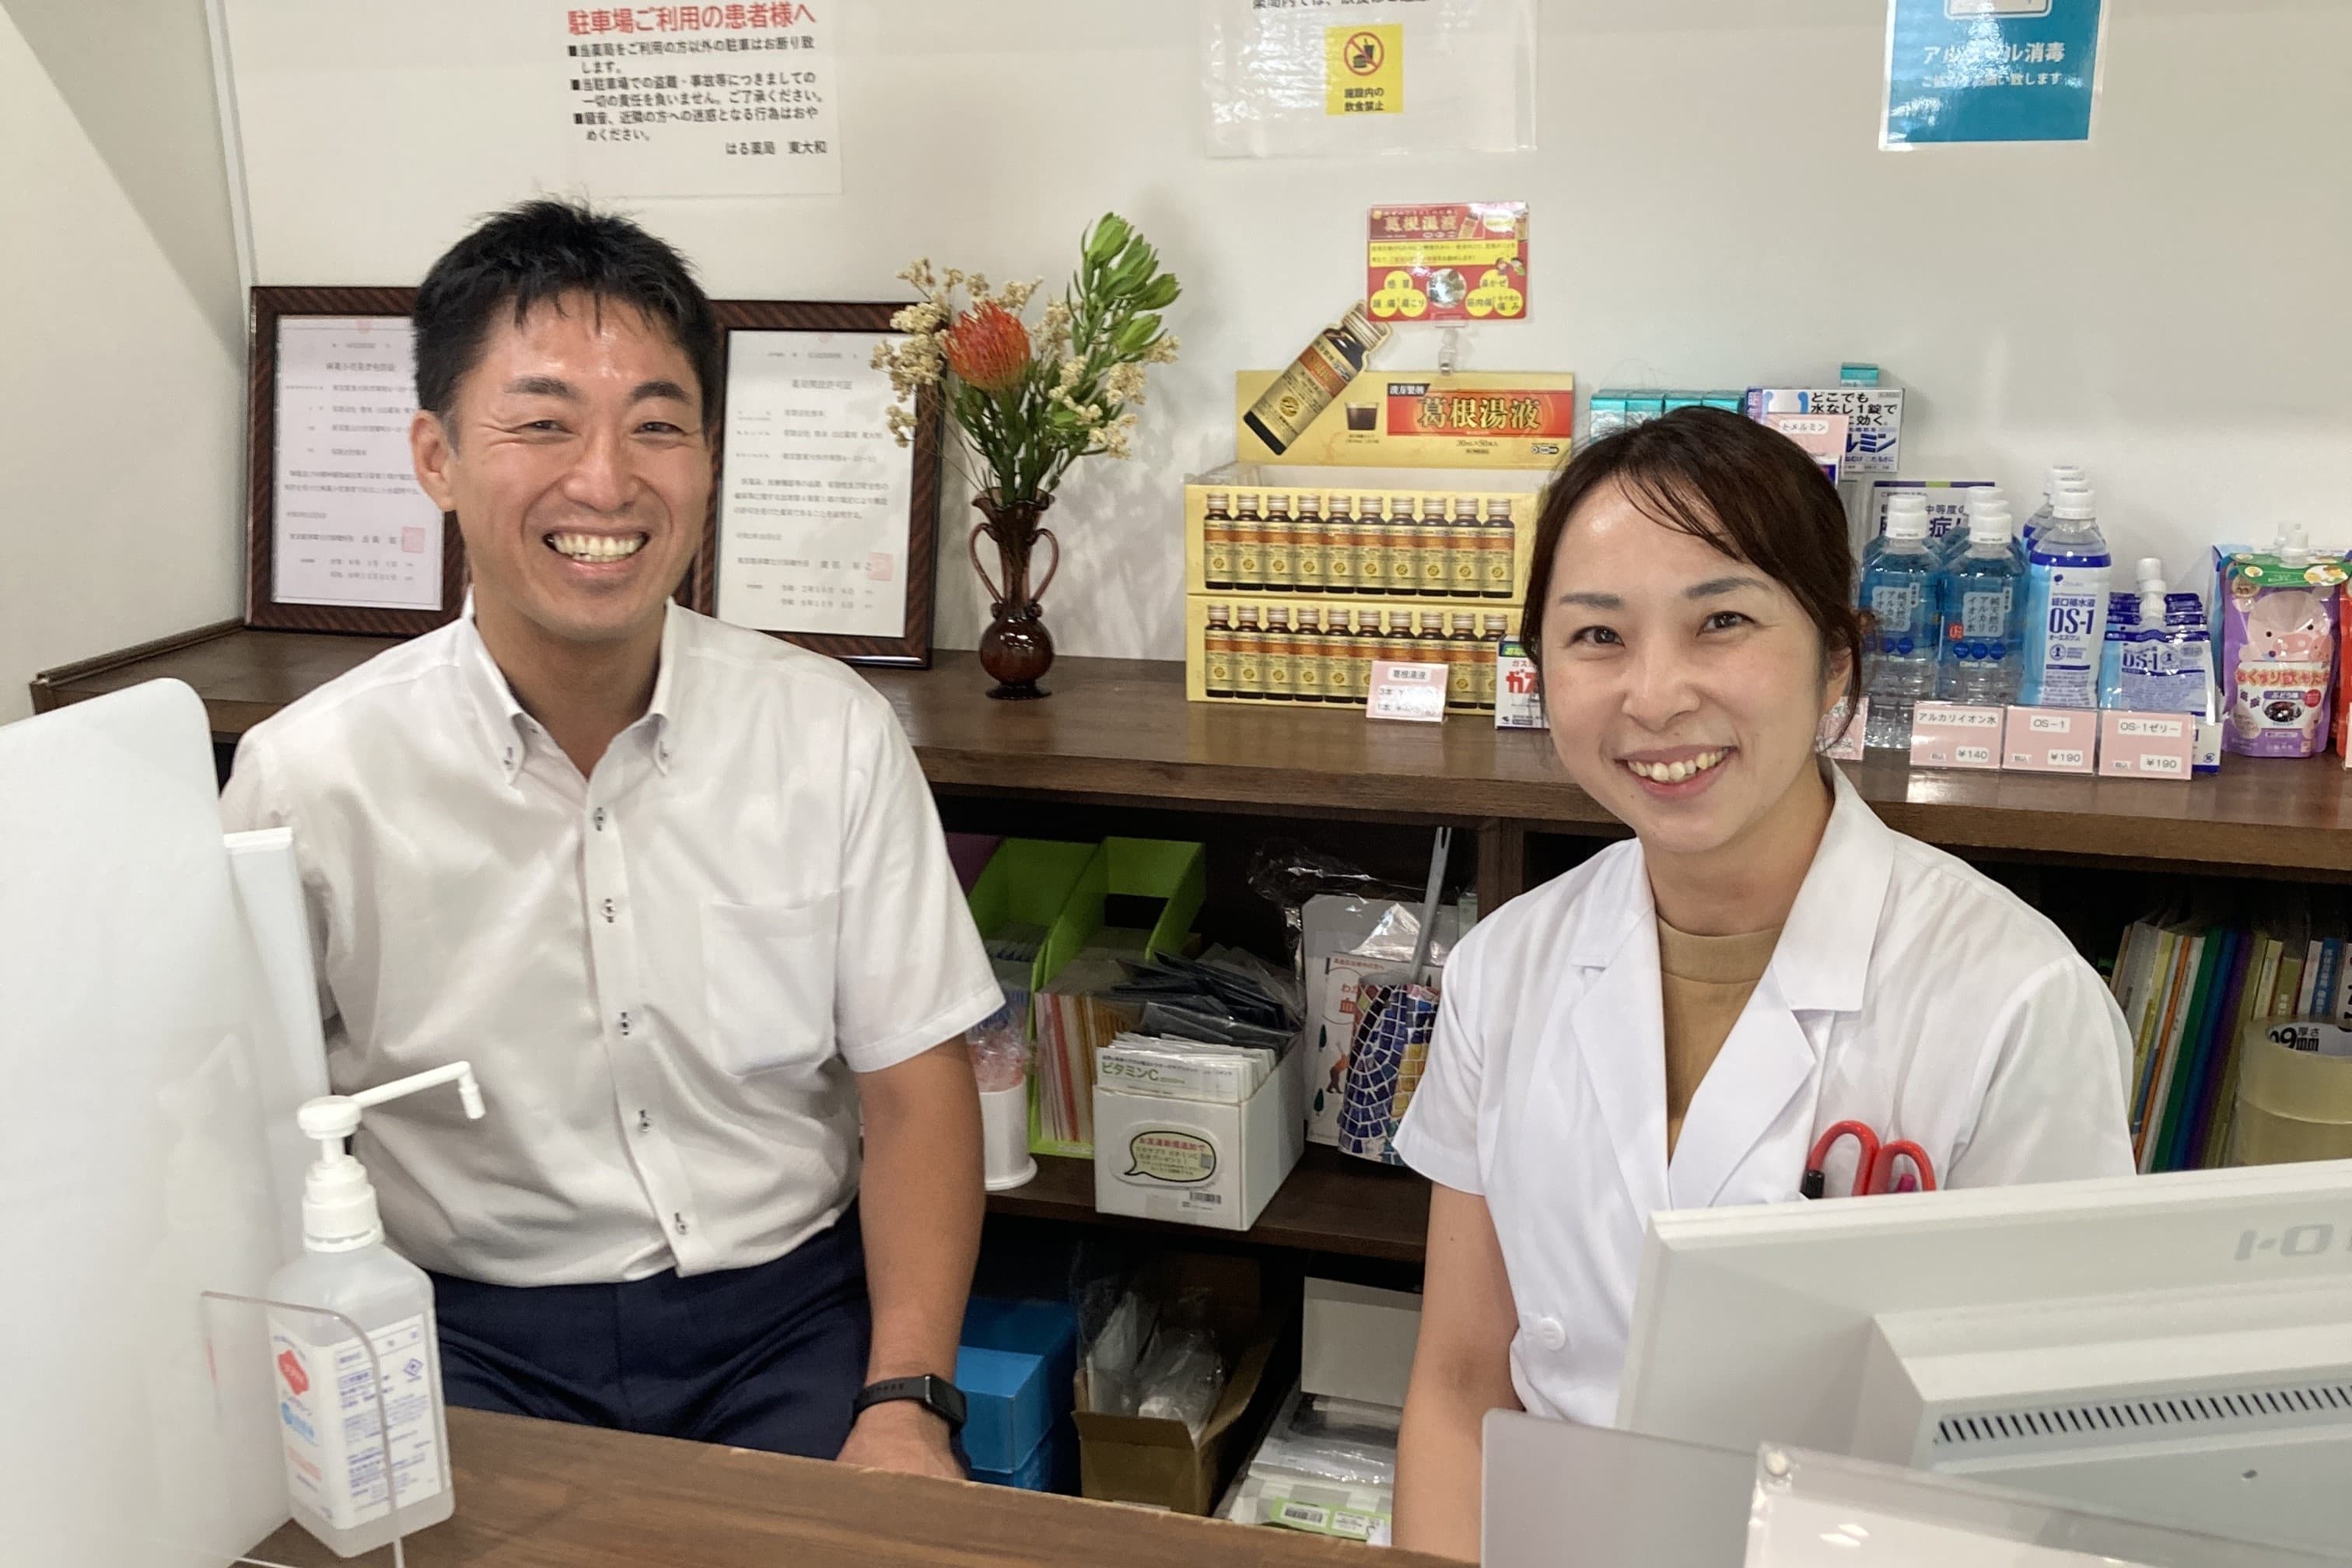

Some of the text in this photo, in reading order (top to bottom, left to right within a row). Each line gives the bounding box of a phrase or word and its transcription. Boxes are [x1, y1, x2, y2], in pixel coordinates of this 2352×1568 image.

[568, 3, 817, 35] 駐車場ご利用の患者様へ
[582, 61, 621, 74] します。
[1344, 100, 1384, 112] 飲食禁止
[586, 129, 650, 142] めください。
[726, 141, 828, 156] はる薬局 東大和
[1811, 391, 1868, 403] どこでも
[1419, 397, 1541, 430] 葛根湯液
[1811, 403, 1898, 415] 水なし1錠で
[1780, 423, 1826, 432] トメルミン
[2052, 597, 2095, 607] 経口補水液
[2049, 607, 2095, 635] OS-1
[1919, 711, 1997, 725] アルカリイオン水
[2032, 718, 2066, 729] OS-1
[1957, 749, 1988, 761] ¥140
[2050, 752, 2081, 764] ¥190
[2146, 758, 2178, 769] ¥190
[2298, 1027, 2320, 1037] 厚さ
[1101, 1061, 1159, 1081] ビタミンC
